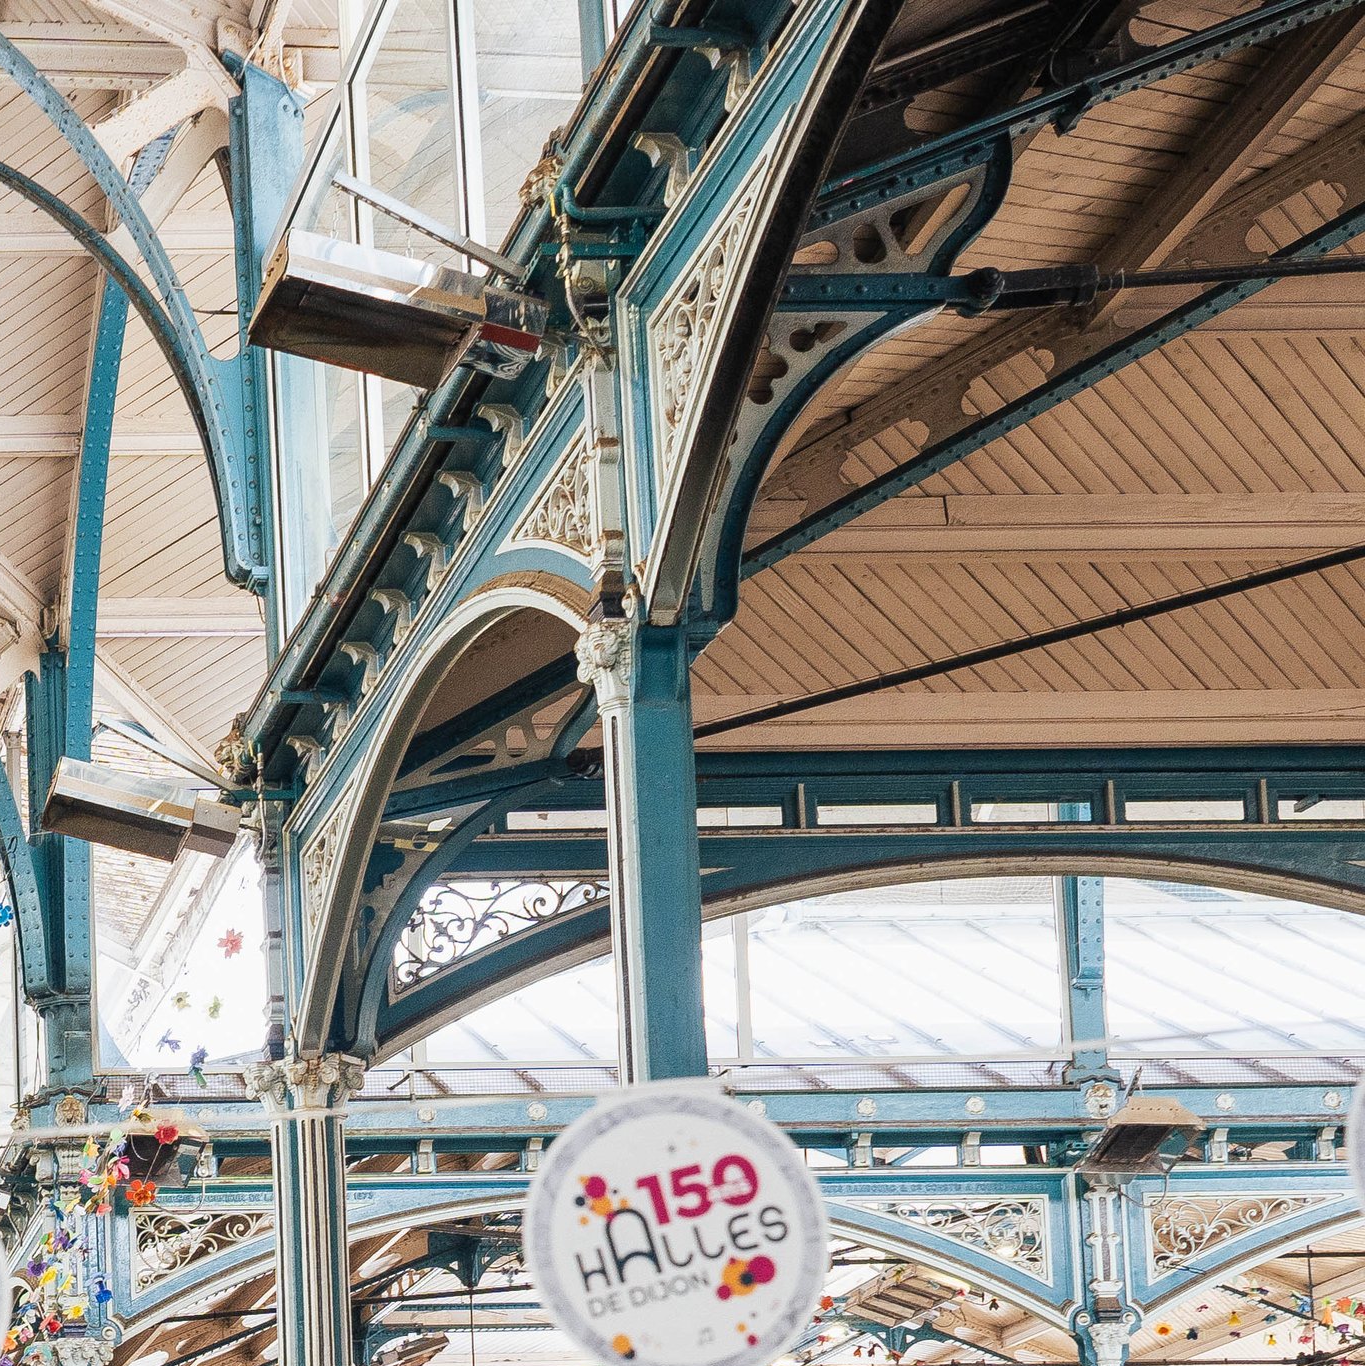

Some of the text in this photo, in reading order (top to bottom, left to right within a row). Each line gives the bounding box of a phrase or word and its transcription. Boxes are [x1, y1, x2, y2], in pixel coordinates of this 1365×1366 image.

[636, 1155, 758, 1226] 150
[575, 1206, 788, 1292] HALLES
[587, 1272, 710, 1318] DE DIJON
